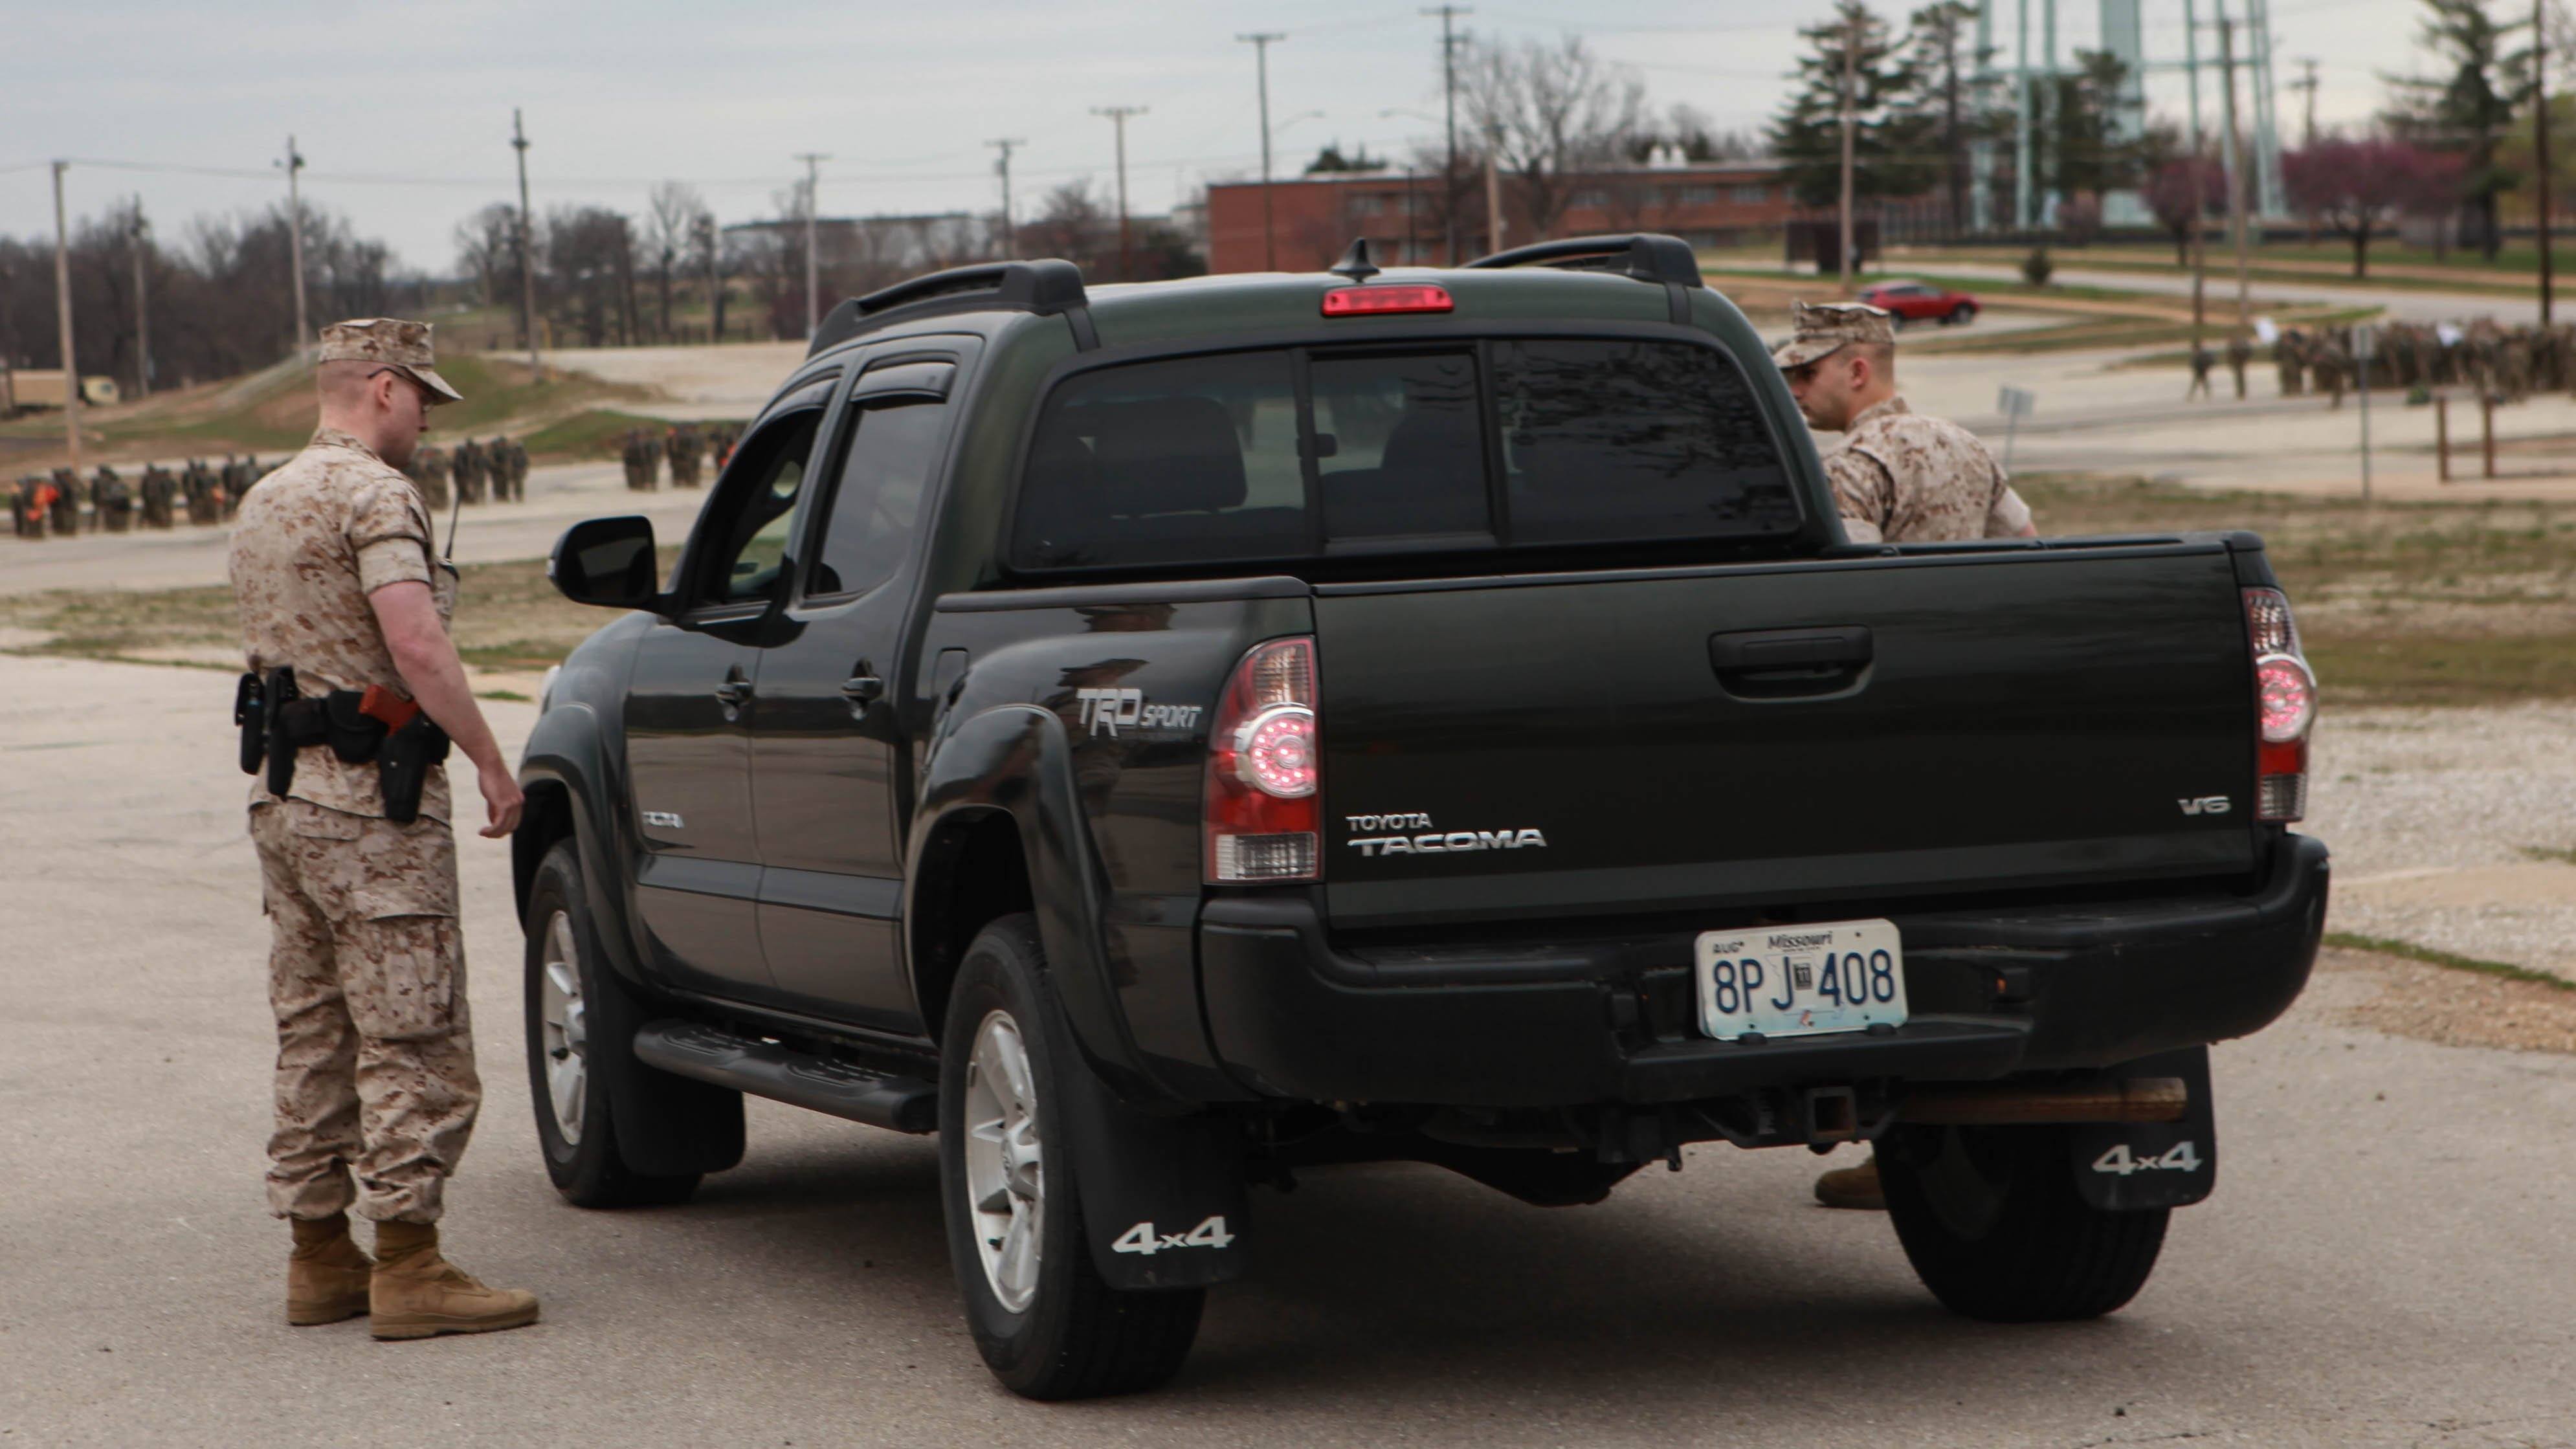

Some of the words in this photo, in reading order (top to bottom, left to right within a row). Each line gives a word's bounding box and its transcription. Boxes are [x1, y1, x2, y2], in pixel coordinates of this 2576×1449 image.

[1076, 688, 1142, 738] TRD
[1140, 704, 1203, 727] SPORT
[2177, 795, 2231, 815] V6
[1346, 813, 1433, 832] TOYOTA
[1347, 829, 1547, 856] TACOMA
[1767, 931, 1833, 949] Missouri
[1819, 949, 1895, 1006] 408
[2091, 1140, 2203, 1175] 4x4
[1111, 1215, 1236, 1255] 4x4
